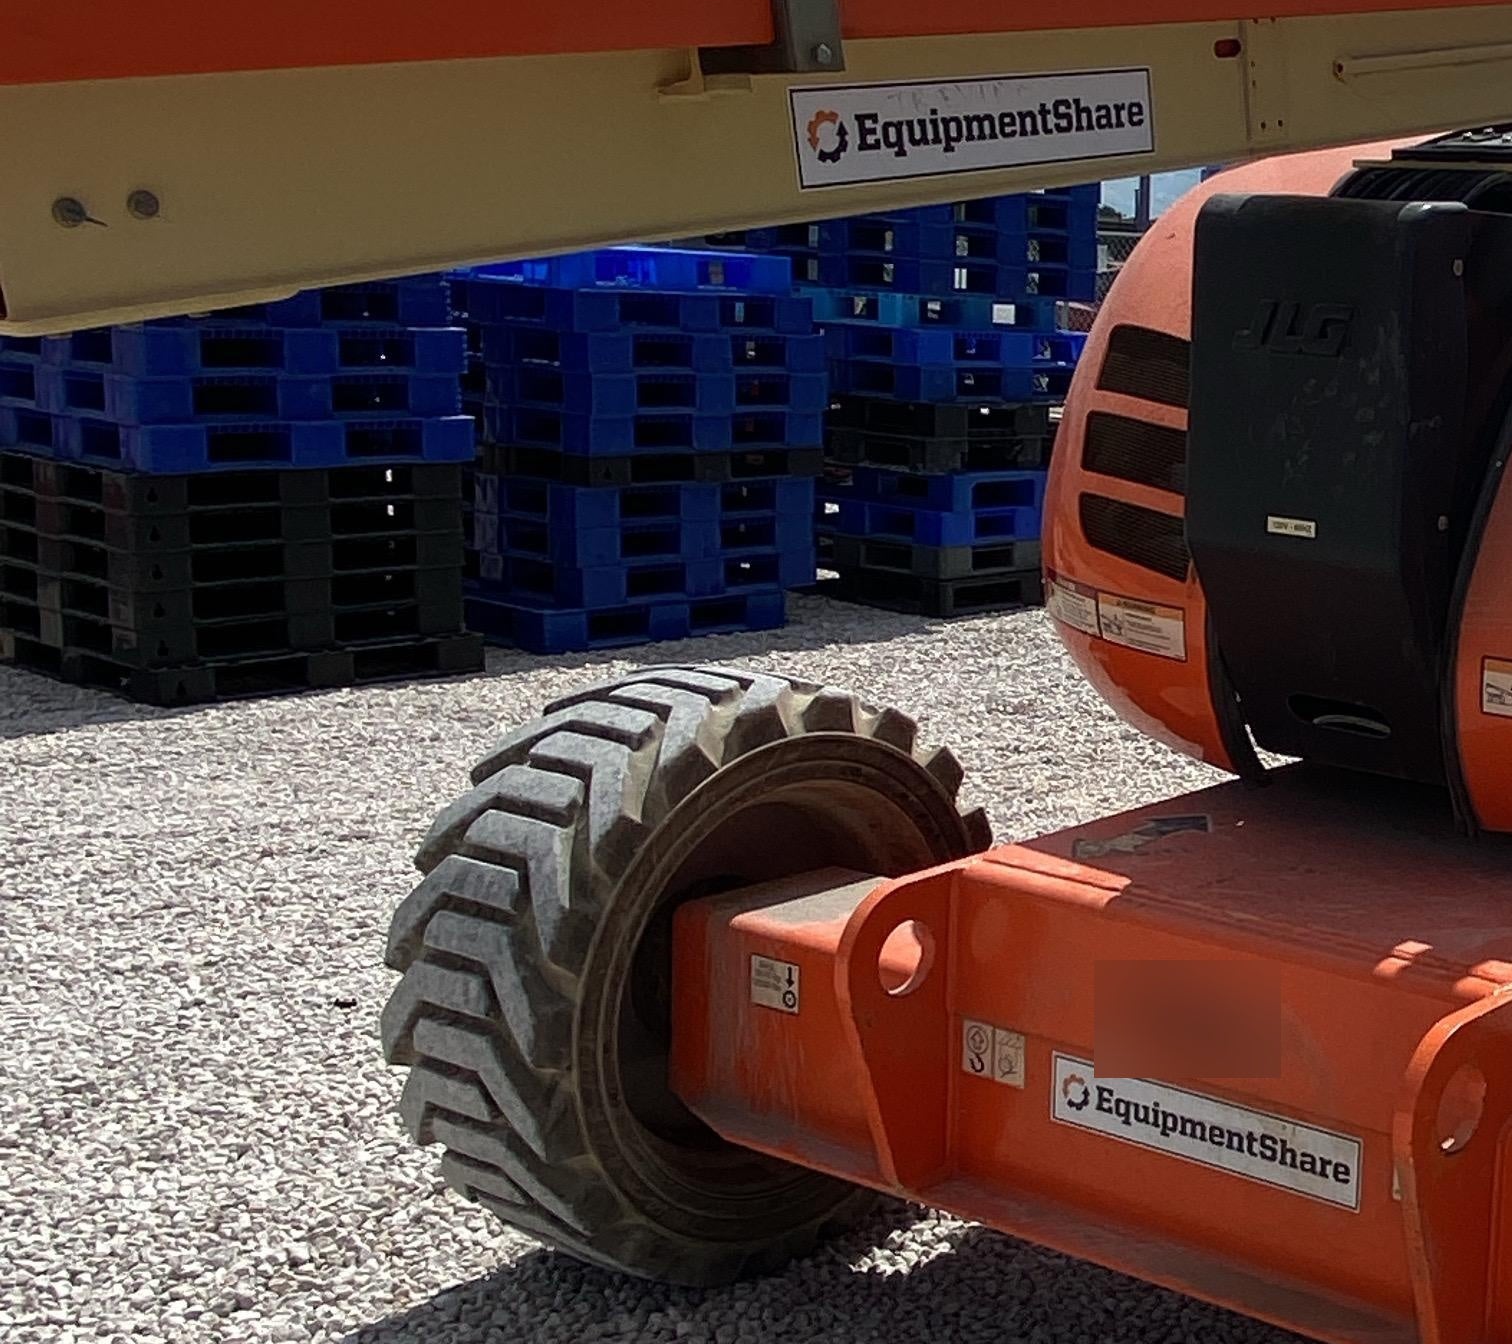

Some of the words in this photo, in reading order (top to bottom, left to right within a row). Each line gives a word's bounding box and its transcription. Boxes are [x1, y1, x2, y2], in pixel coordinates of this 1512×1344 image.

[854, 97, 1144, 157] EquipmentShare
[1232, 298, 1355, 356] JLG
[1095, 1085, 1350, 1185] EquipmentShare
